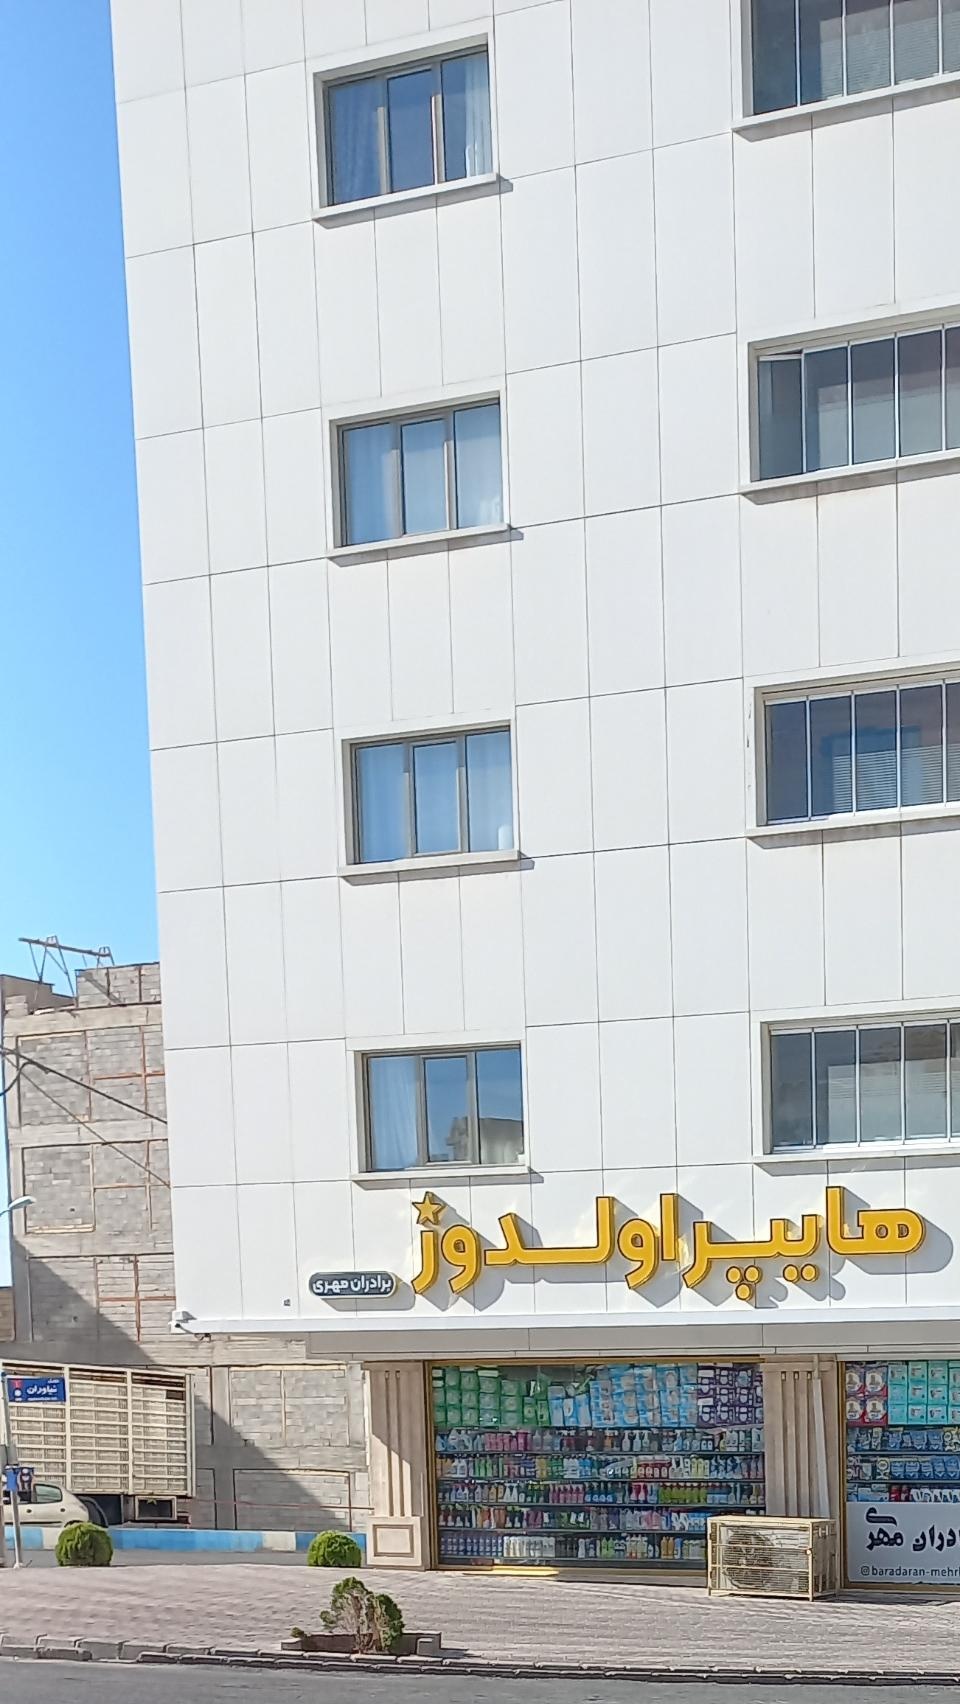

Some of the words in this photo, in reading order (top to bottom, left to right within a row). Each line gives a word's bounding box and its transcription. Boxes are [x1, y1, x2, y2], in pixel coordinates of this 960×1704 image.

[684, 1185, 925, 1301] هایپر
[312, 1279, 349, 1294] مهری
[350, 1275, 392, 1293] برادران
[865, 1506, 904, 1551] مهری
